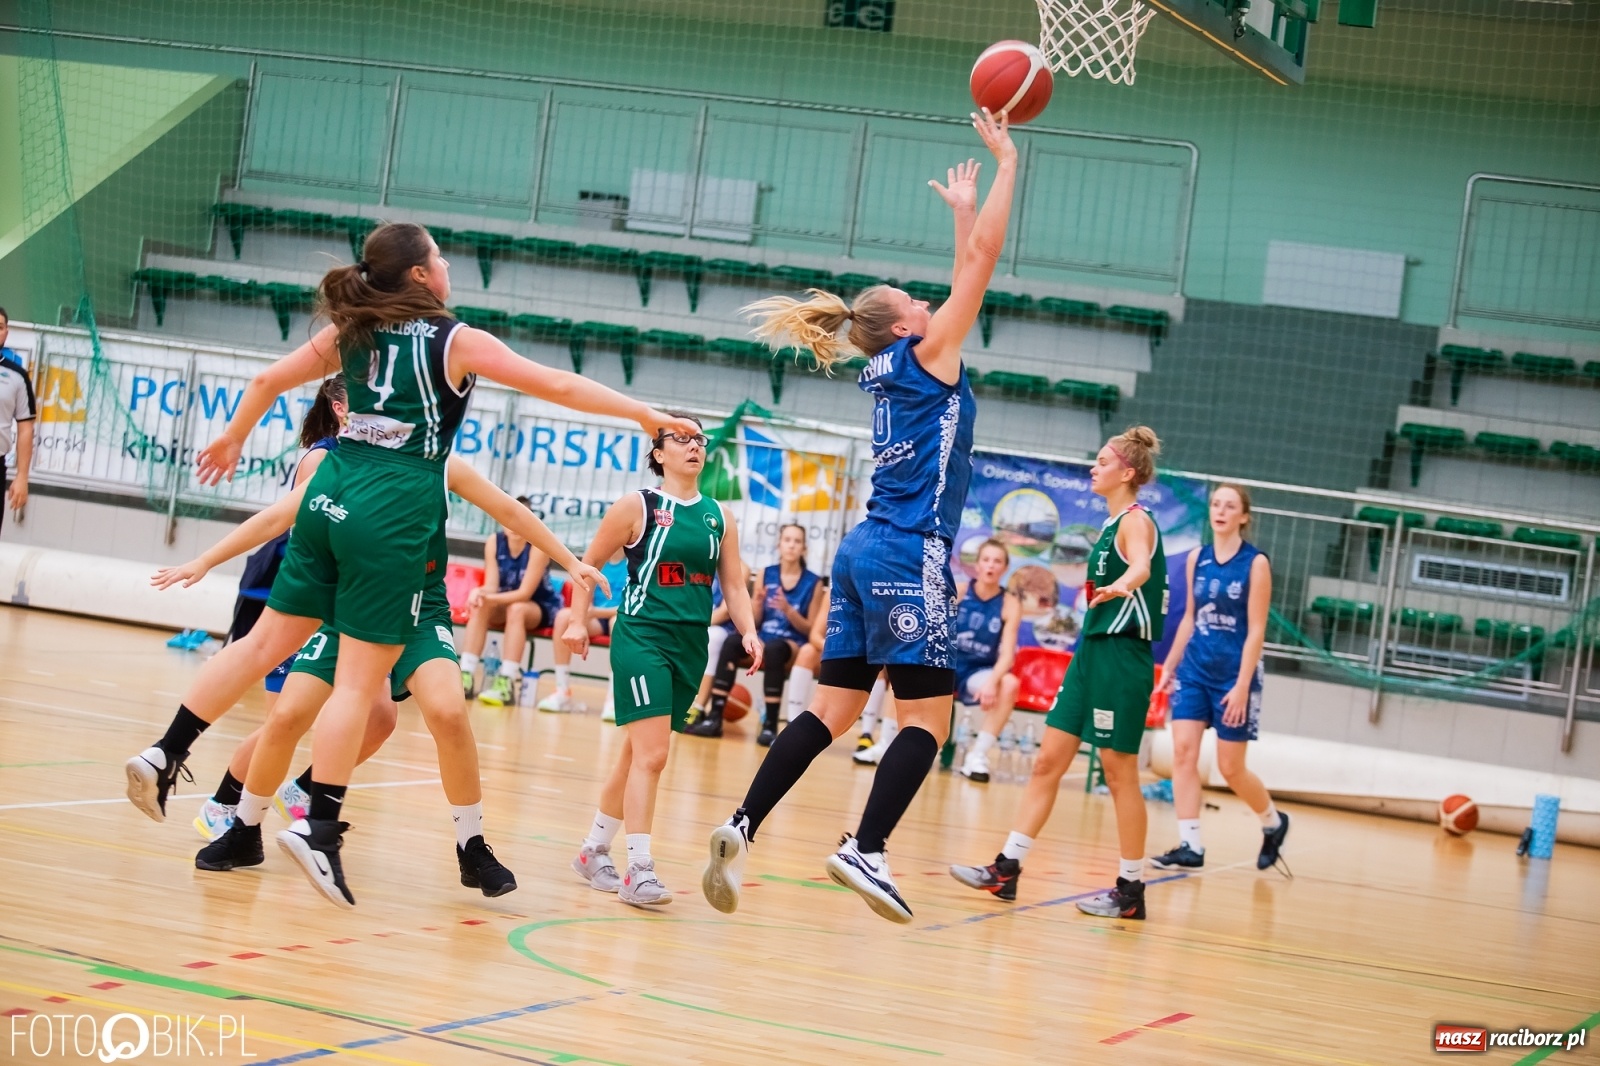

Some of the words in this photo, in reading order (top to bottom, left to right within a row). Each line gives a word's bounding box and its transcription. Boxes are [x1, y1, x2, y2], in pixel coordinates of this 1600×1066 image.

[367, 344, 400, 411] 4
[660, 565, 683, 584] K
[411, 590, 424, 627] 4
[897, 589, 923, 597] LOUD
[630, 674, 651, 707] 11
